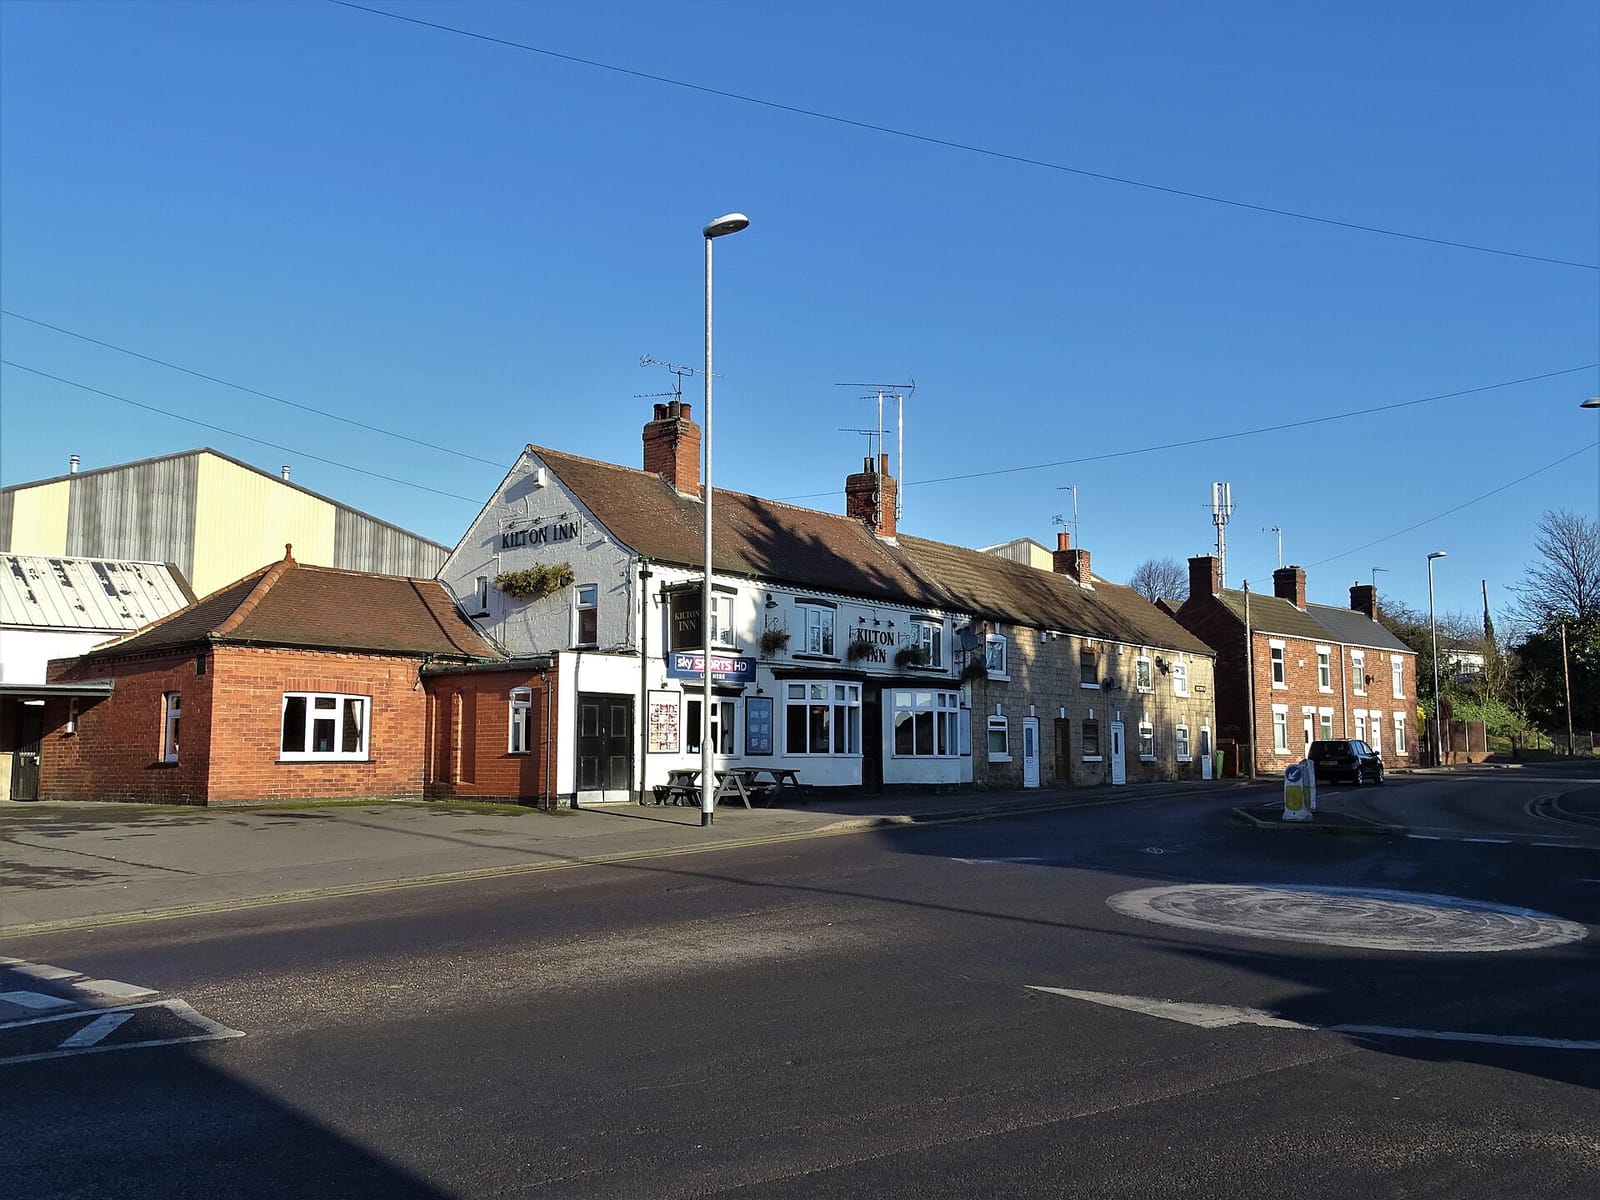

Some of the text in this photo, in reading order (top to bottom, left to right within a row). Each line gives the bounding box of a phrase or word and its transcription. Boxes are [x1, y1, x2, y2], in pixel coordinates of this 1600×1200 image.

[502, 521, 578, 549] KILTON INN
[674, 609, 700, 621] KILTON
[679, 619, 696, 632] INN
[857, 628, 895, 646] KILTON
[677, 656, 747, 672] sky SPRTS HD
